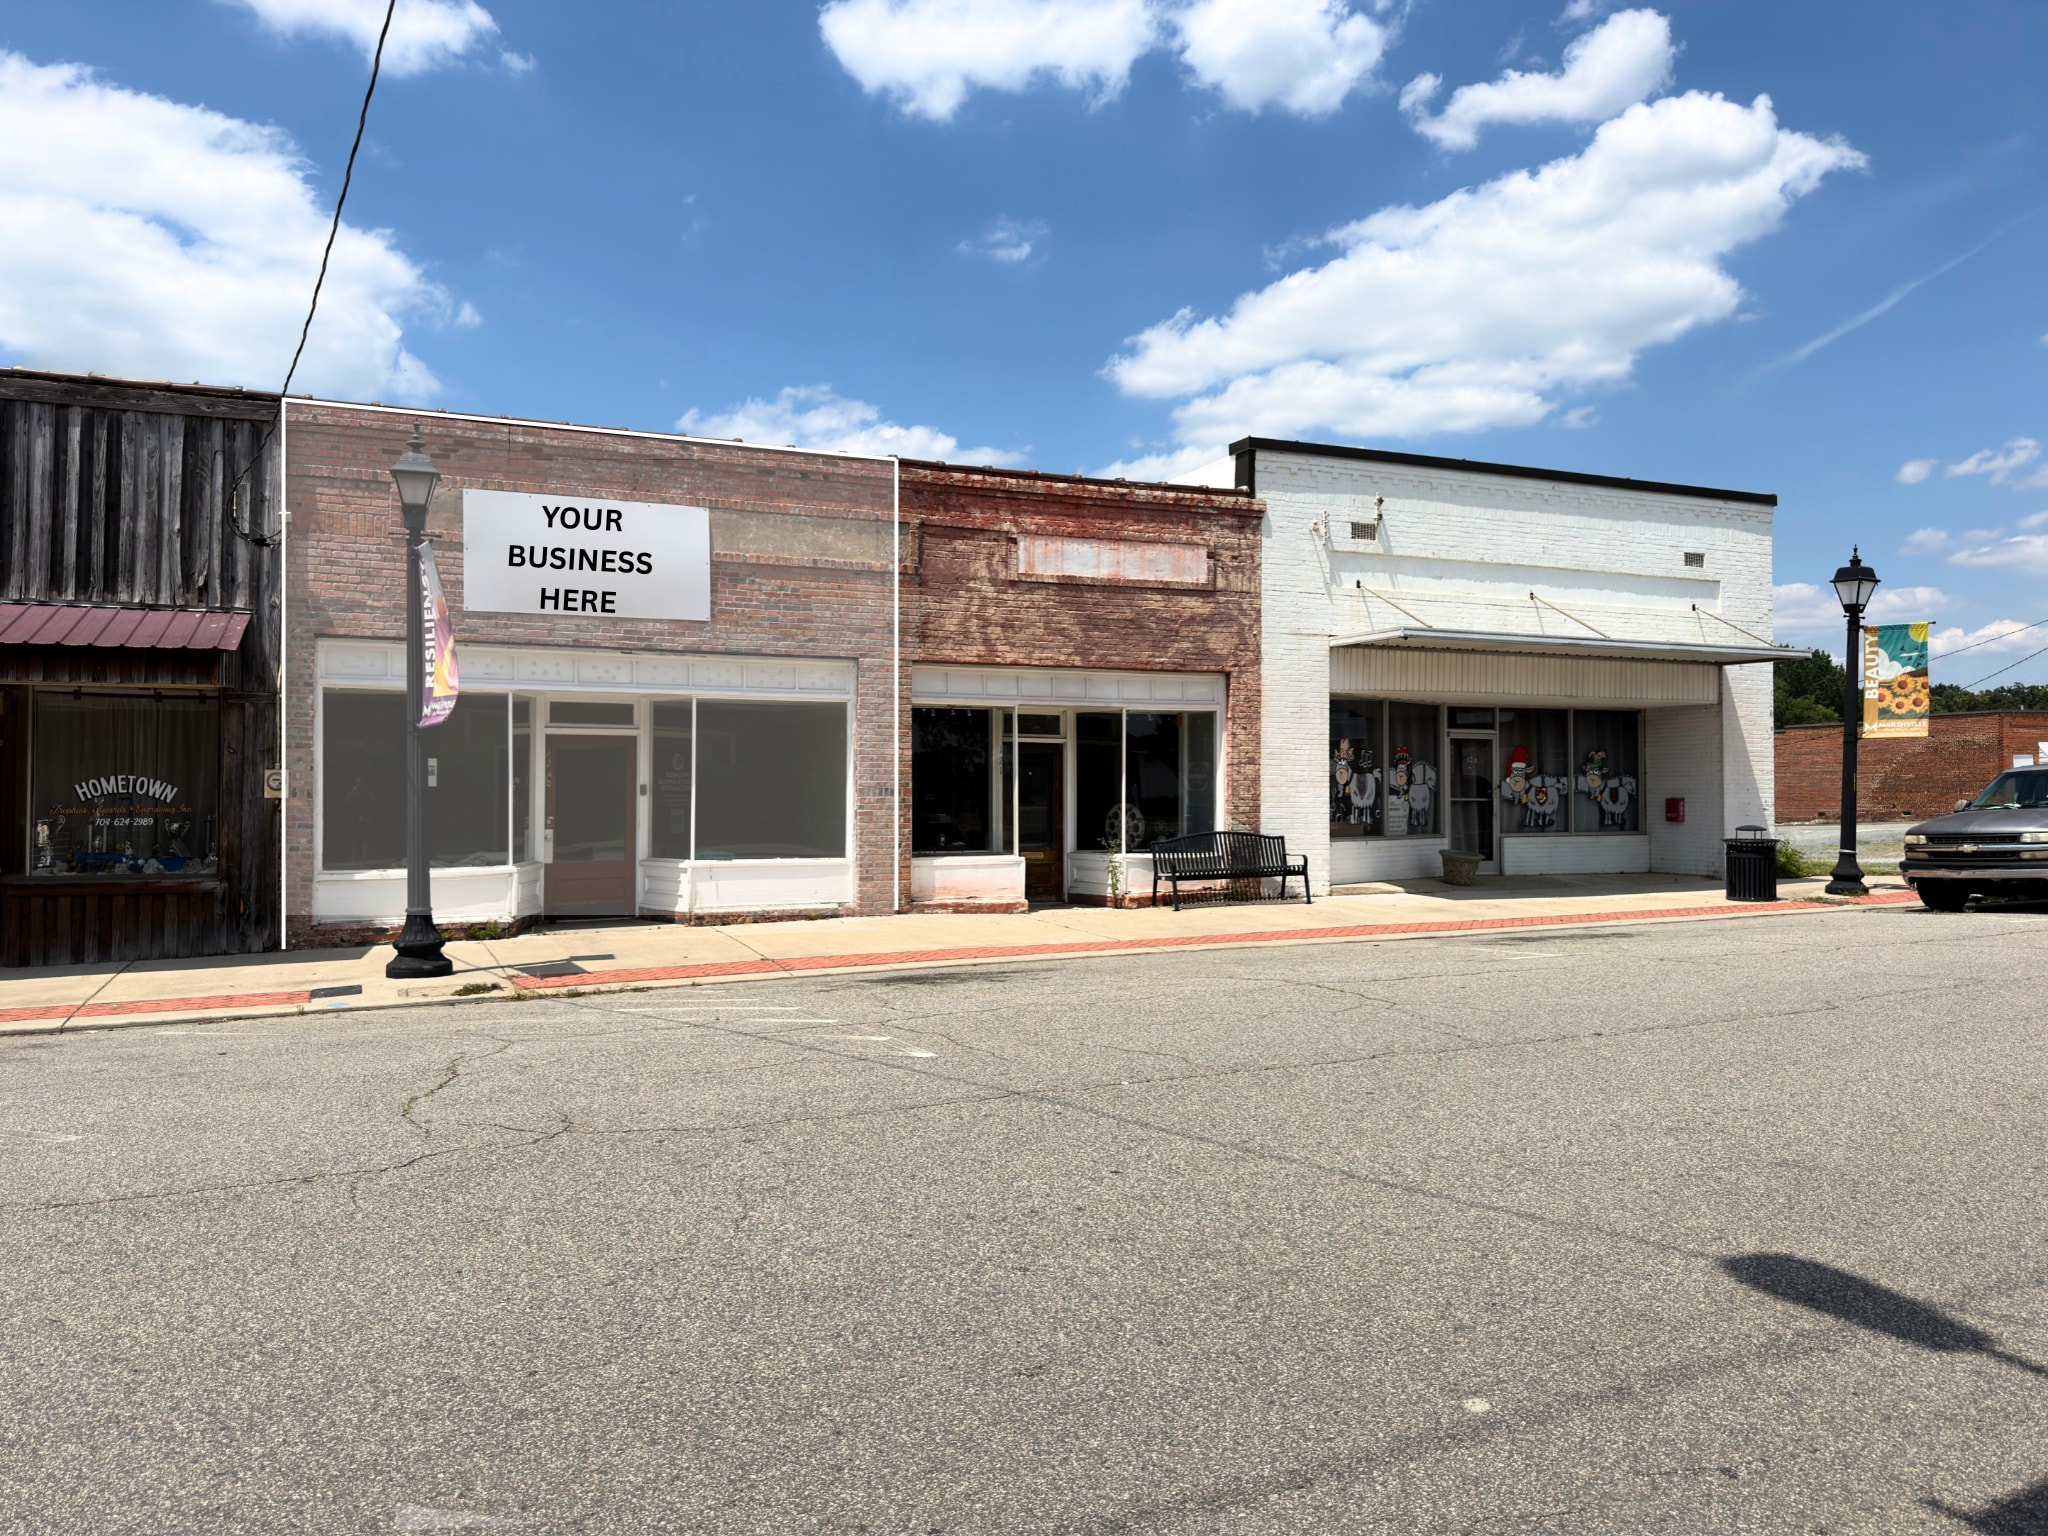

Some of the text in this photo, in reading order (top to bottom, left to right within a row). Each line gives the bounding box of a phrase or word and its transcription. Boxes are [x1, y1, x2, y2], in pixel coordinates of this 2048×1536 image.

[542, 505, 623, 532] YOUR
[508, 545, 653, 575] BUSINESS
[540, 587, 617, 614] HERE
[1865, 635, 1879, 699] BEAUTY
[74, 775, 178, 804] HOMETOWN
[95, 817, 154, 826] 704-624-2989
